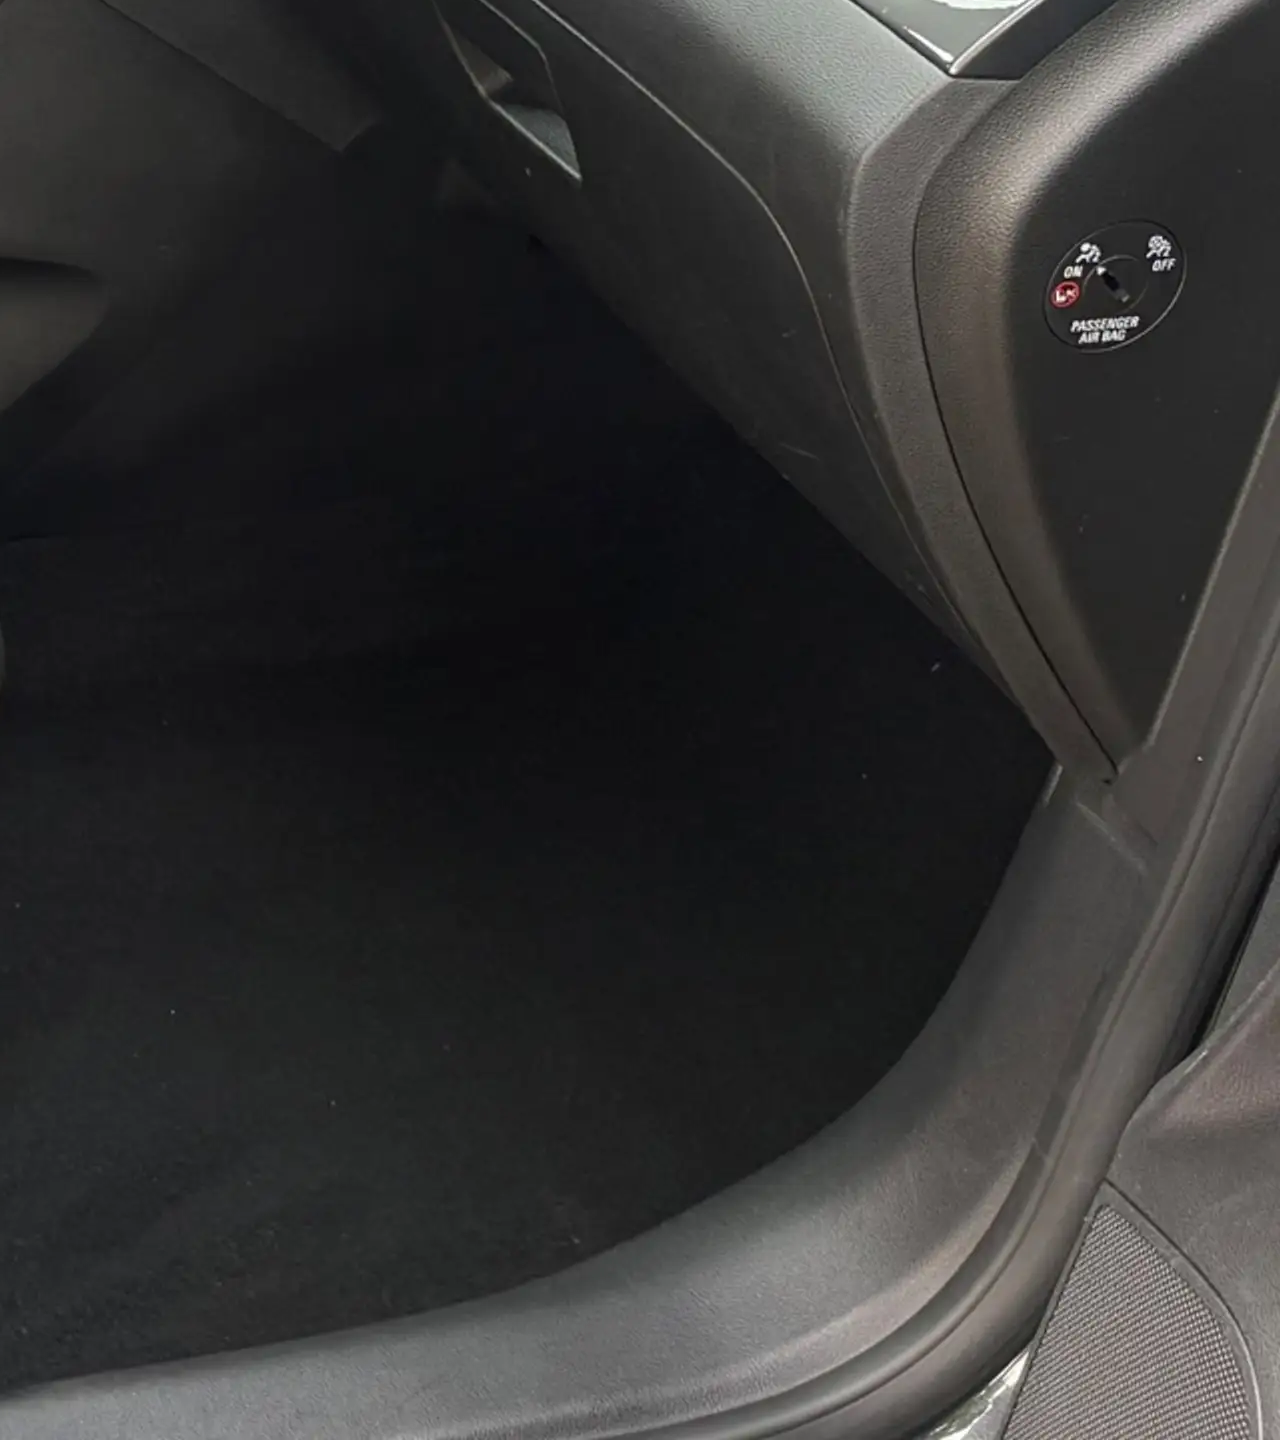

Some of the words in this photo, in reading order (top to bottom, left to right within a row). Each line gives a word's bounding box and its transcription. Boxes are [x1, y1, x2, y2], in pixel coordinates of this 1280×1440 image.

[1152, 259, 1176, 271] OFF
[1064, 266, 1083, 278] ON
[1070, 316, 1140, 332] PASSENGER
[1078, 332, 1100, 344] AIR
[1102, 329, 1127, 342] BAG
